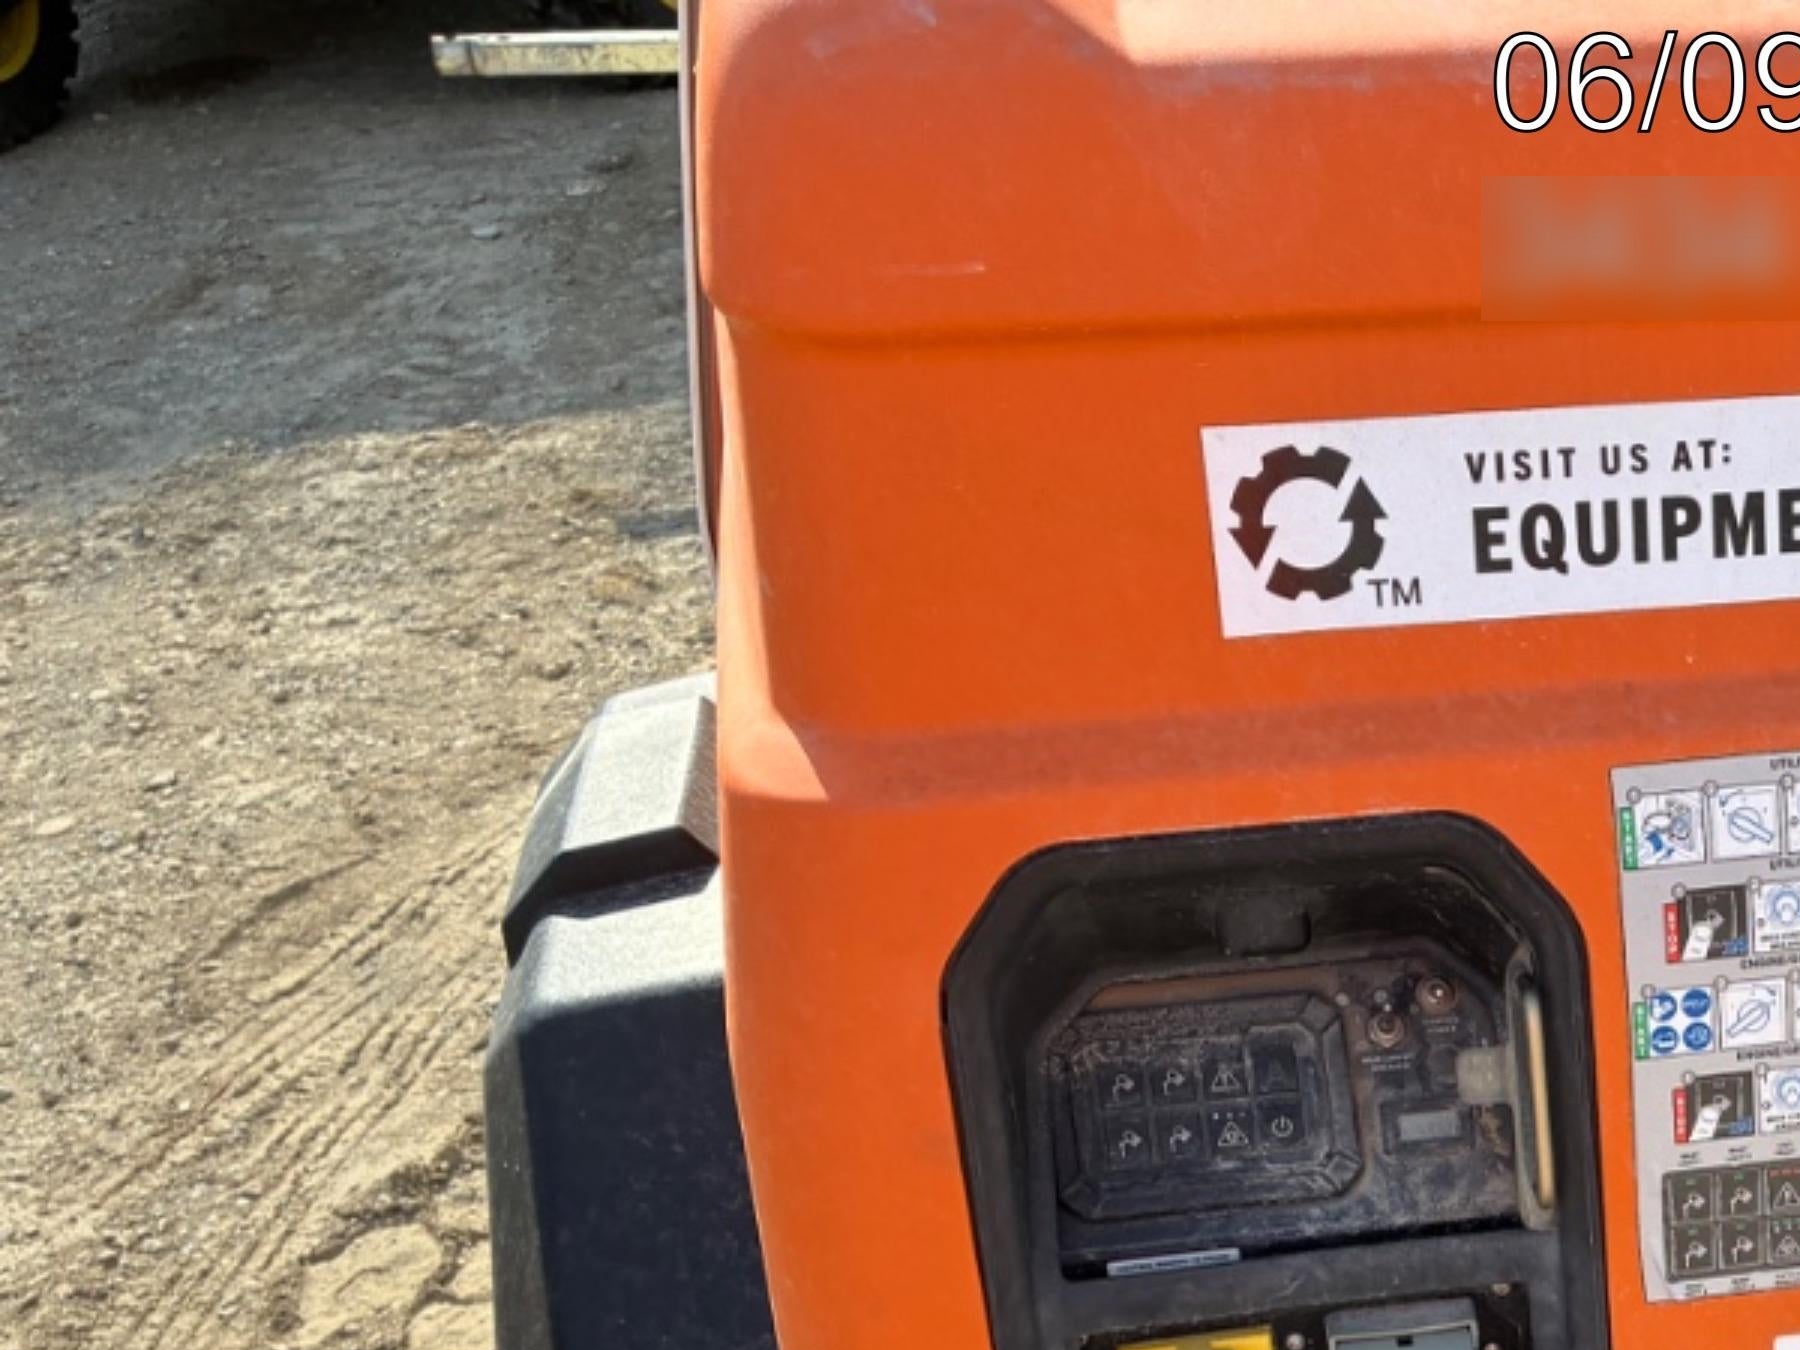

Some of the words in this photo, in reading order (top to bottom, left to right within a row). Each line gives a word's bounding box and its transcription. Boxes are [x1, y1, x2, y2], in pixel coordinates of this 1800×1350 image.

[1464, 447, 1576, 484] VISIT
[1600, 443, 1649, 476] US
[1672, 439, 1731, 472] AT:
[1366, 576, 1422, 608] TM
